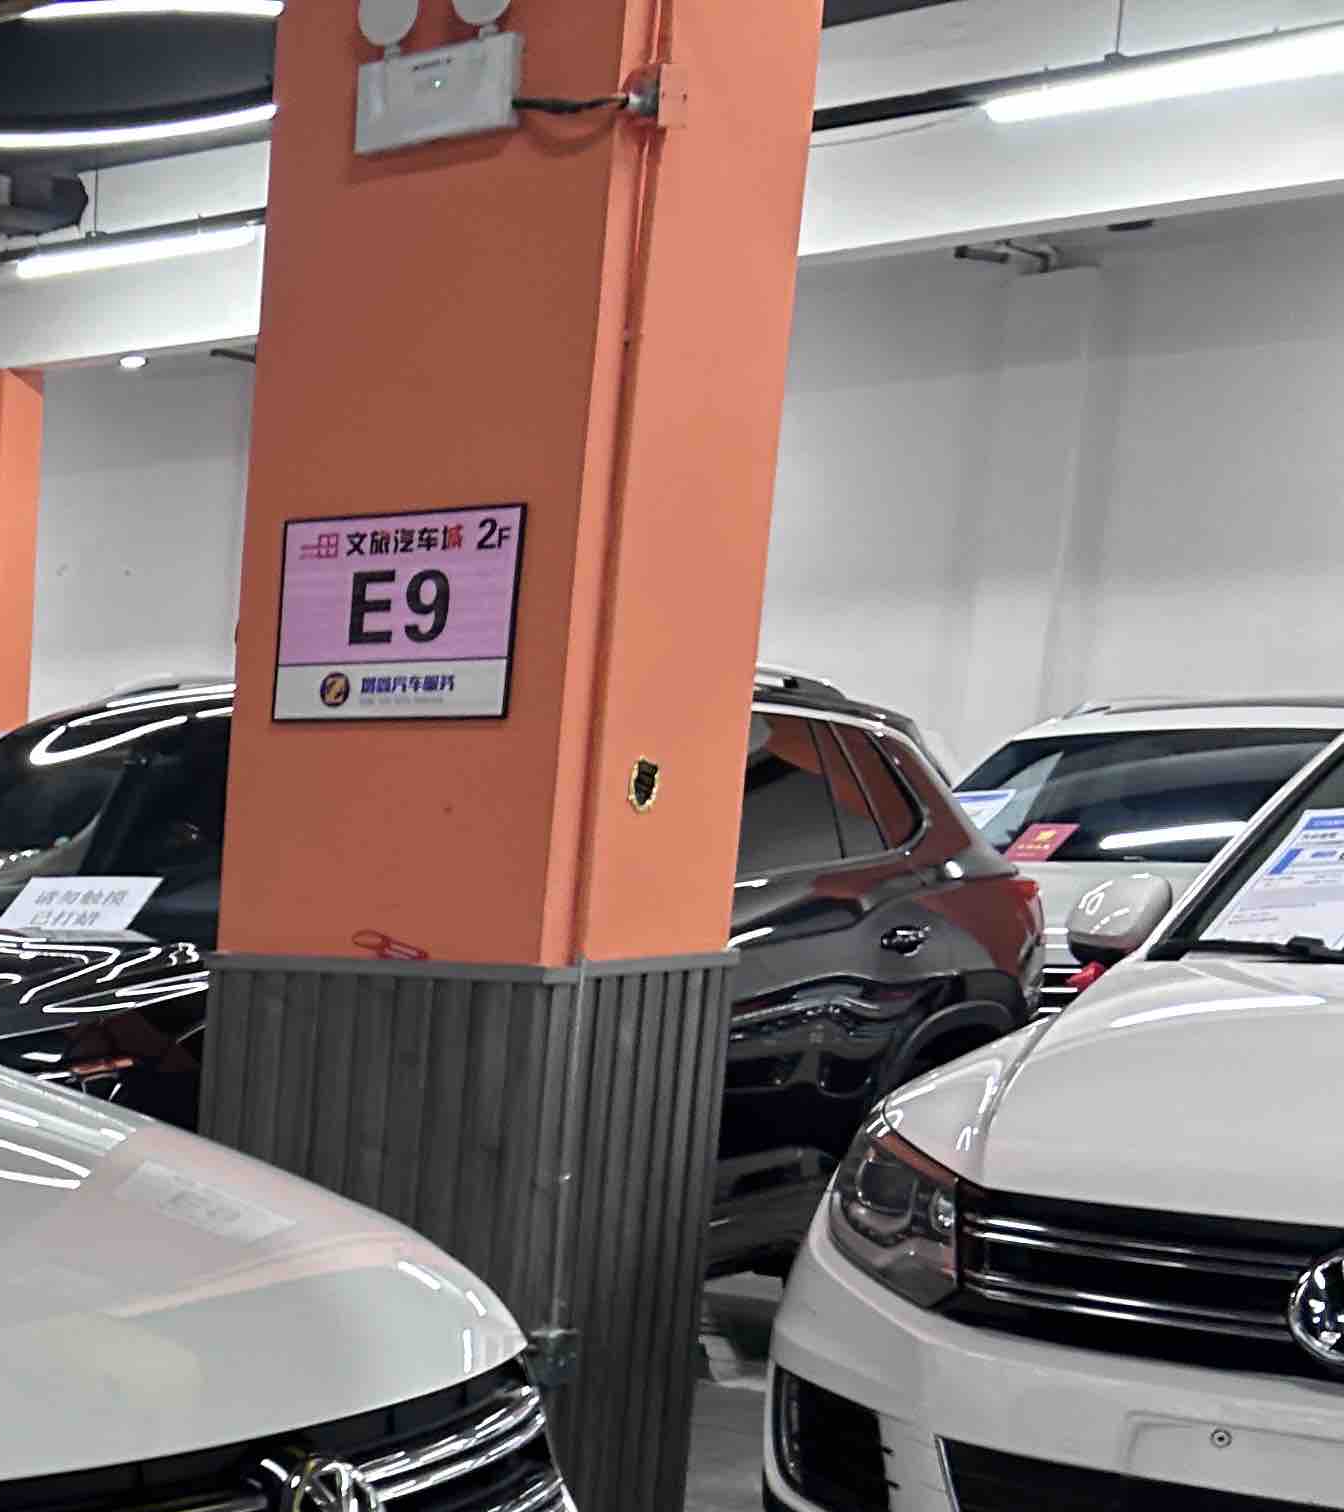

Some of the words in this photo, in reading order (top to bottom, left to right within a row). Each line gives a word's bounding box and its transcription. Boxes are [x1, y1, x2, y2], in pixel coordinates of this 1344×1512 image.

[345, 524, 465, 557] 文旅汽车城
[476, 517, 511, 550] 2F
[348, 568, 451, 646] E9
